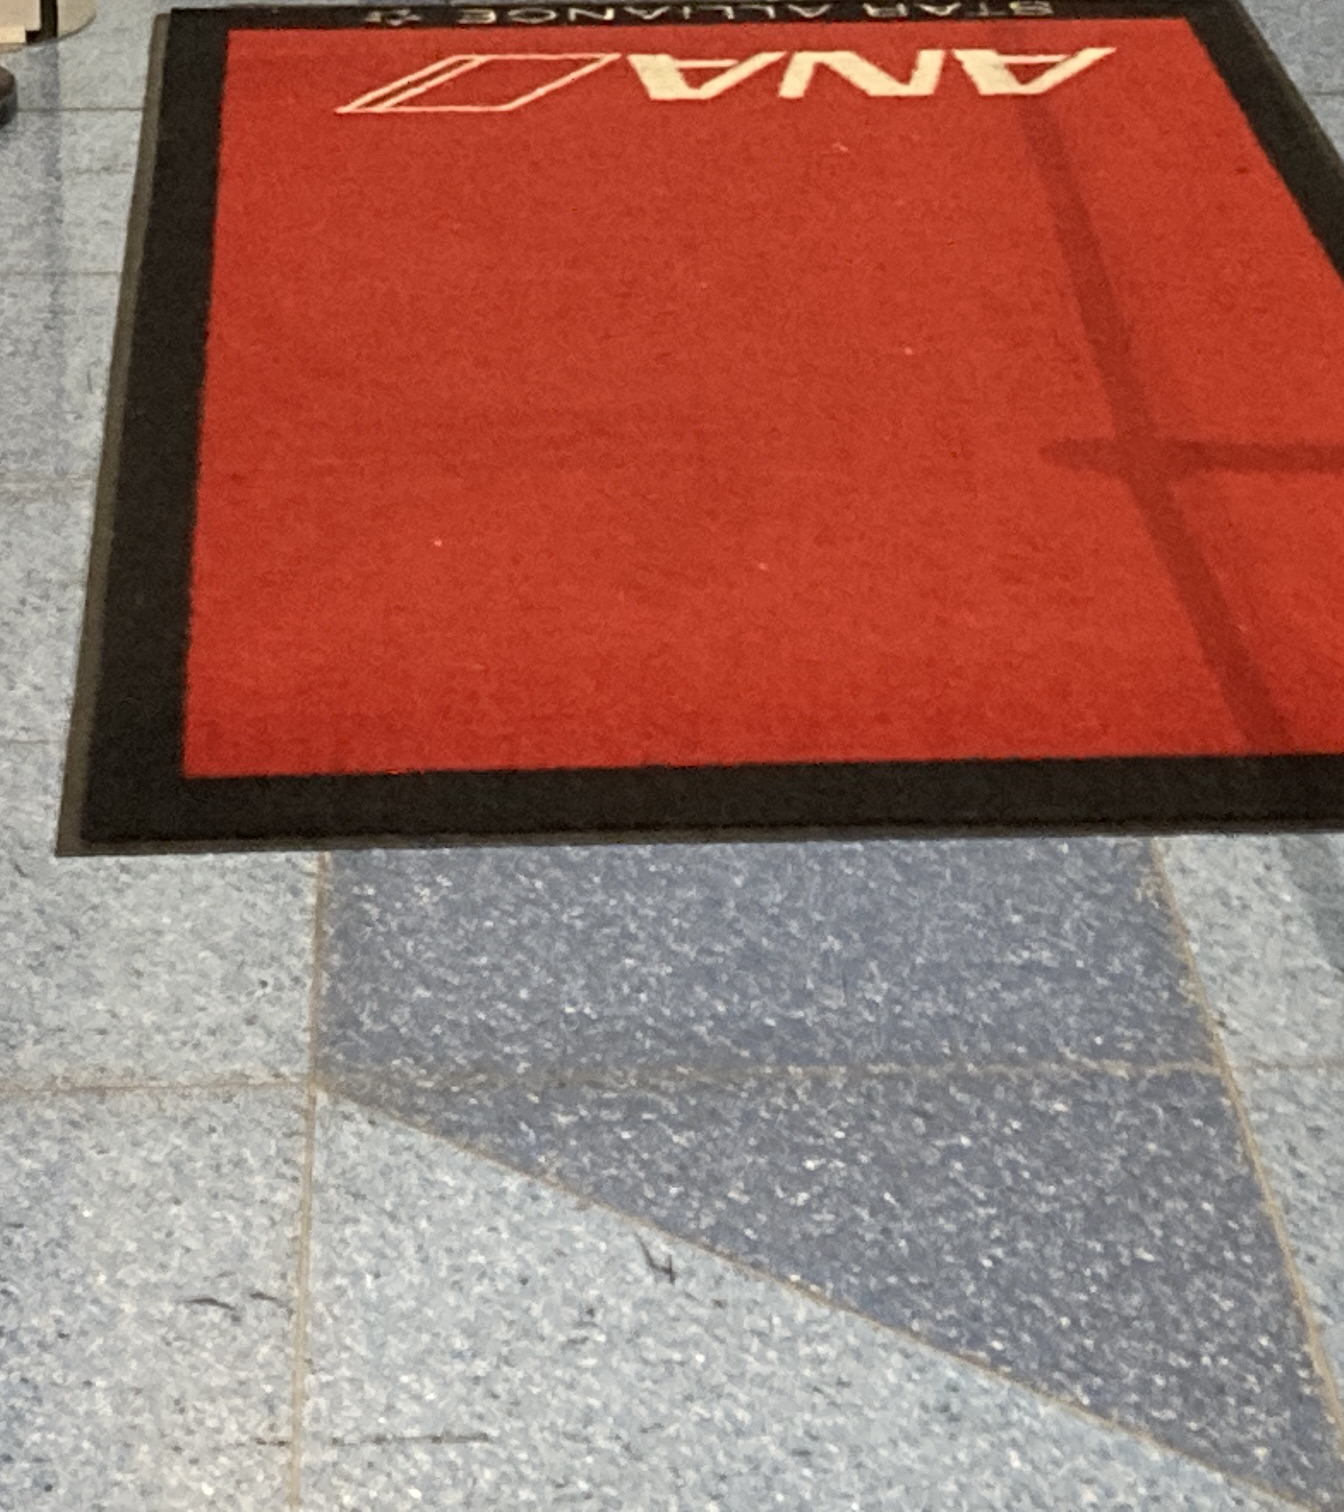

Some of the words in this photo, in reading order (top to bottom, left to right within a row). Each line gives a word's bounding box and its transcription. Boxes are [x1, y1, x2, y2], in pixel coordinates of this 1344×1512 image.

[458, 1, 832, 25] ALLIANCE
[862, 0, 1054, 19] STAR
[627, 47, 1117, 100] ANA
